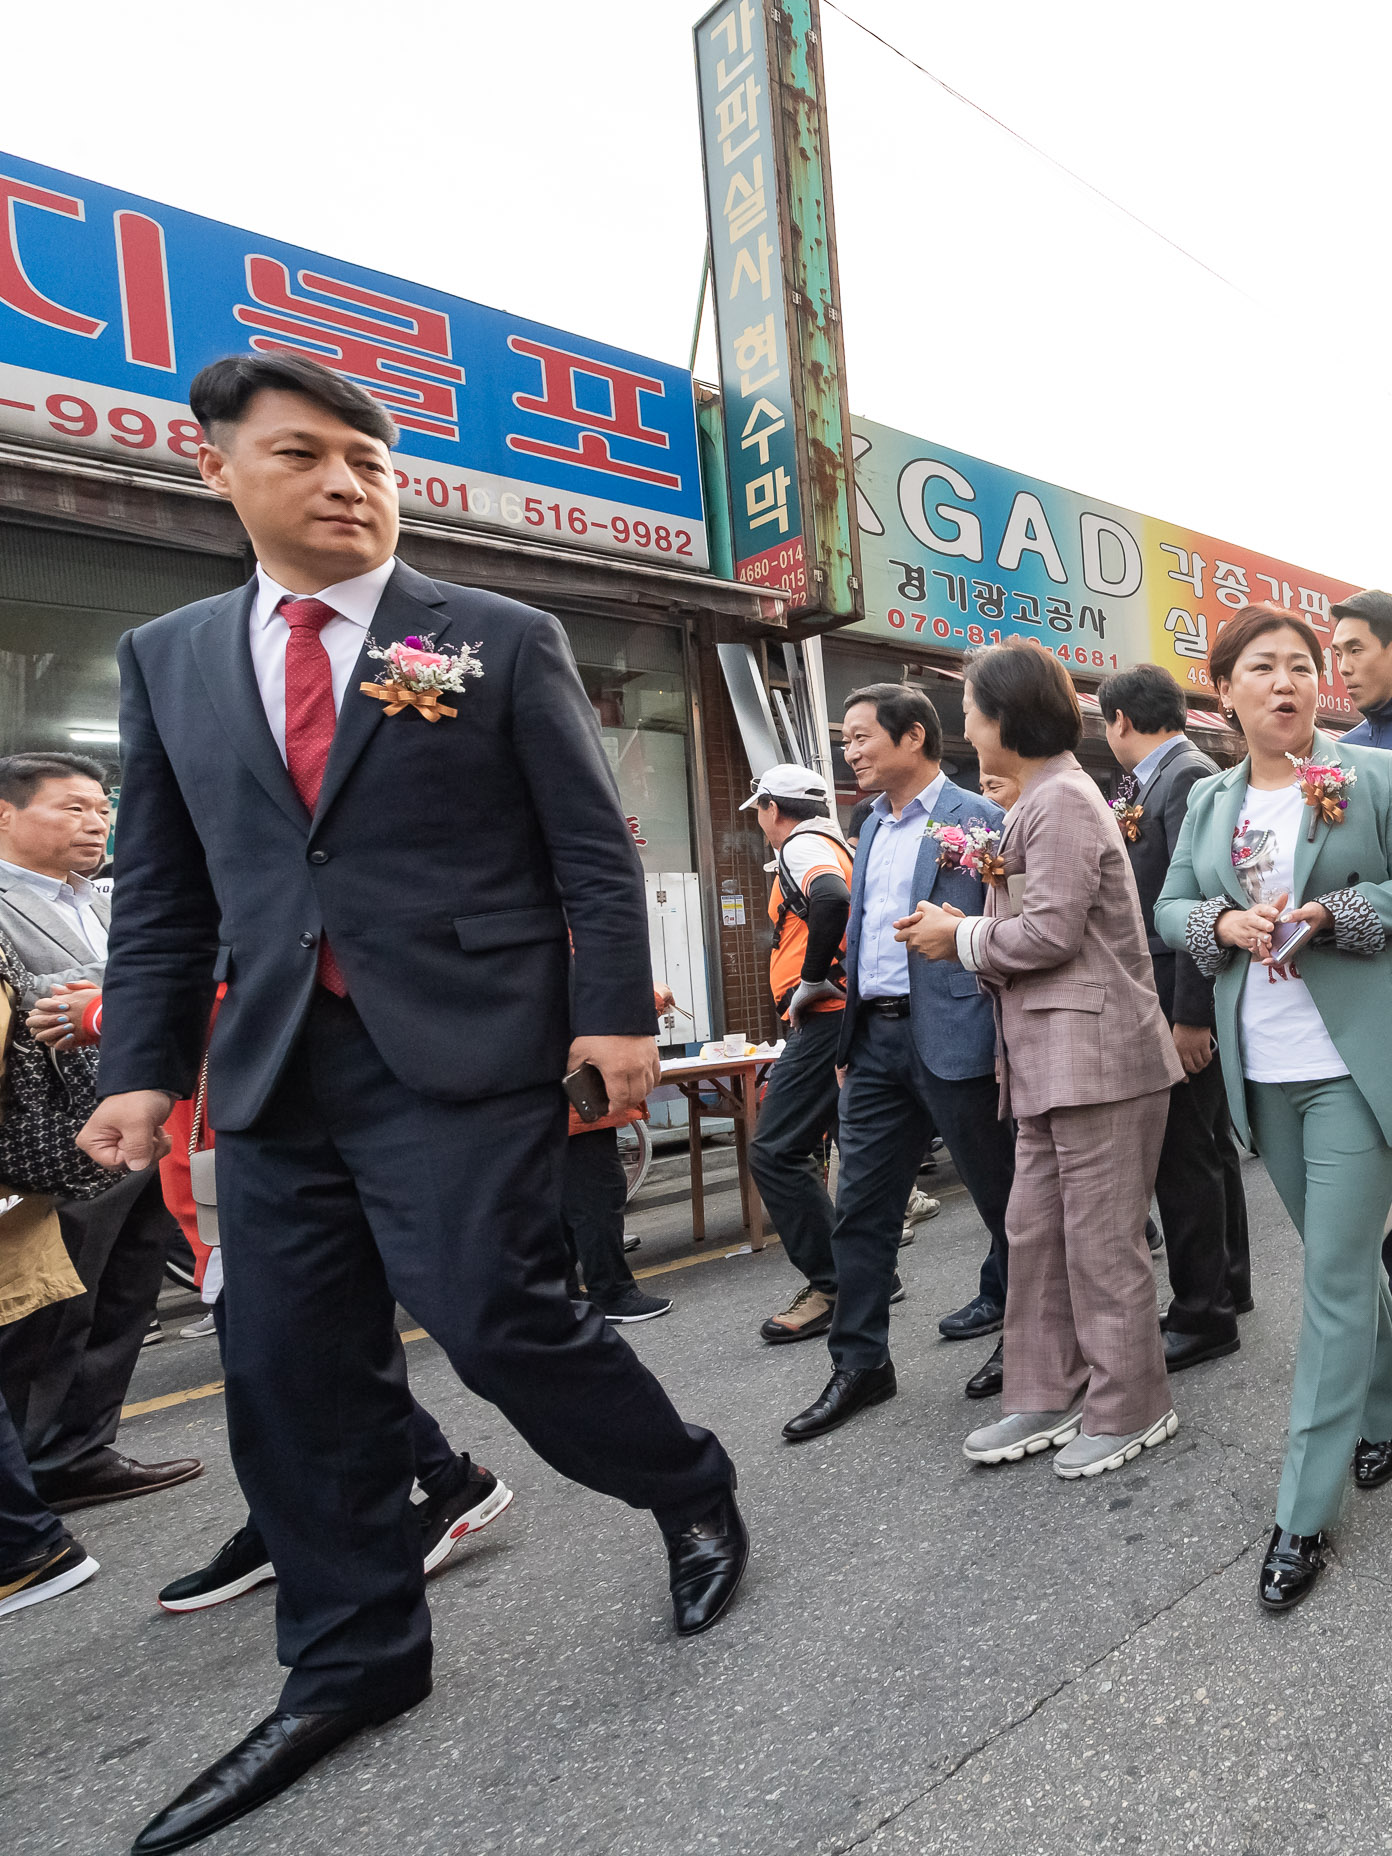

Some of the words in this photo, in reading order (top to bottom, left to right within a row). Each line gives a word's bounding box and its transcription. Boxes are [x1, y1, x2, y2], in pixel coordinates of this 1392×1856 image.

[711, 0, 774, 301] 간판실사
[733, 313, 789, 535] 현수막
[740, 544, 803, 583] 4680-014
[888, 558, 1108, 640] 경기광고공사
[887, 608, 1119, 670] 070-81-4681
